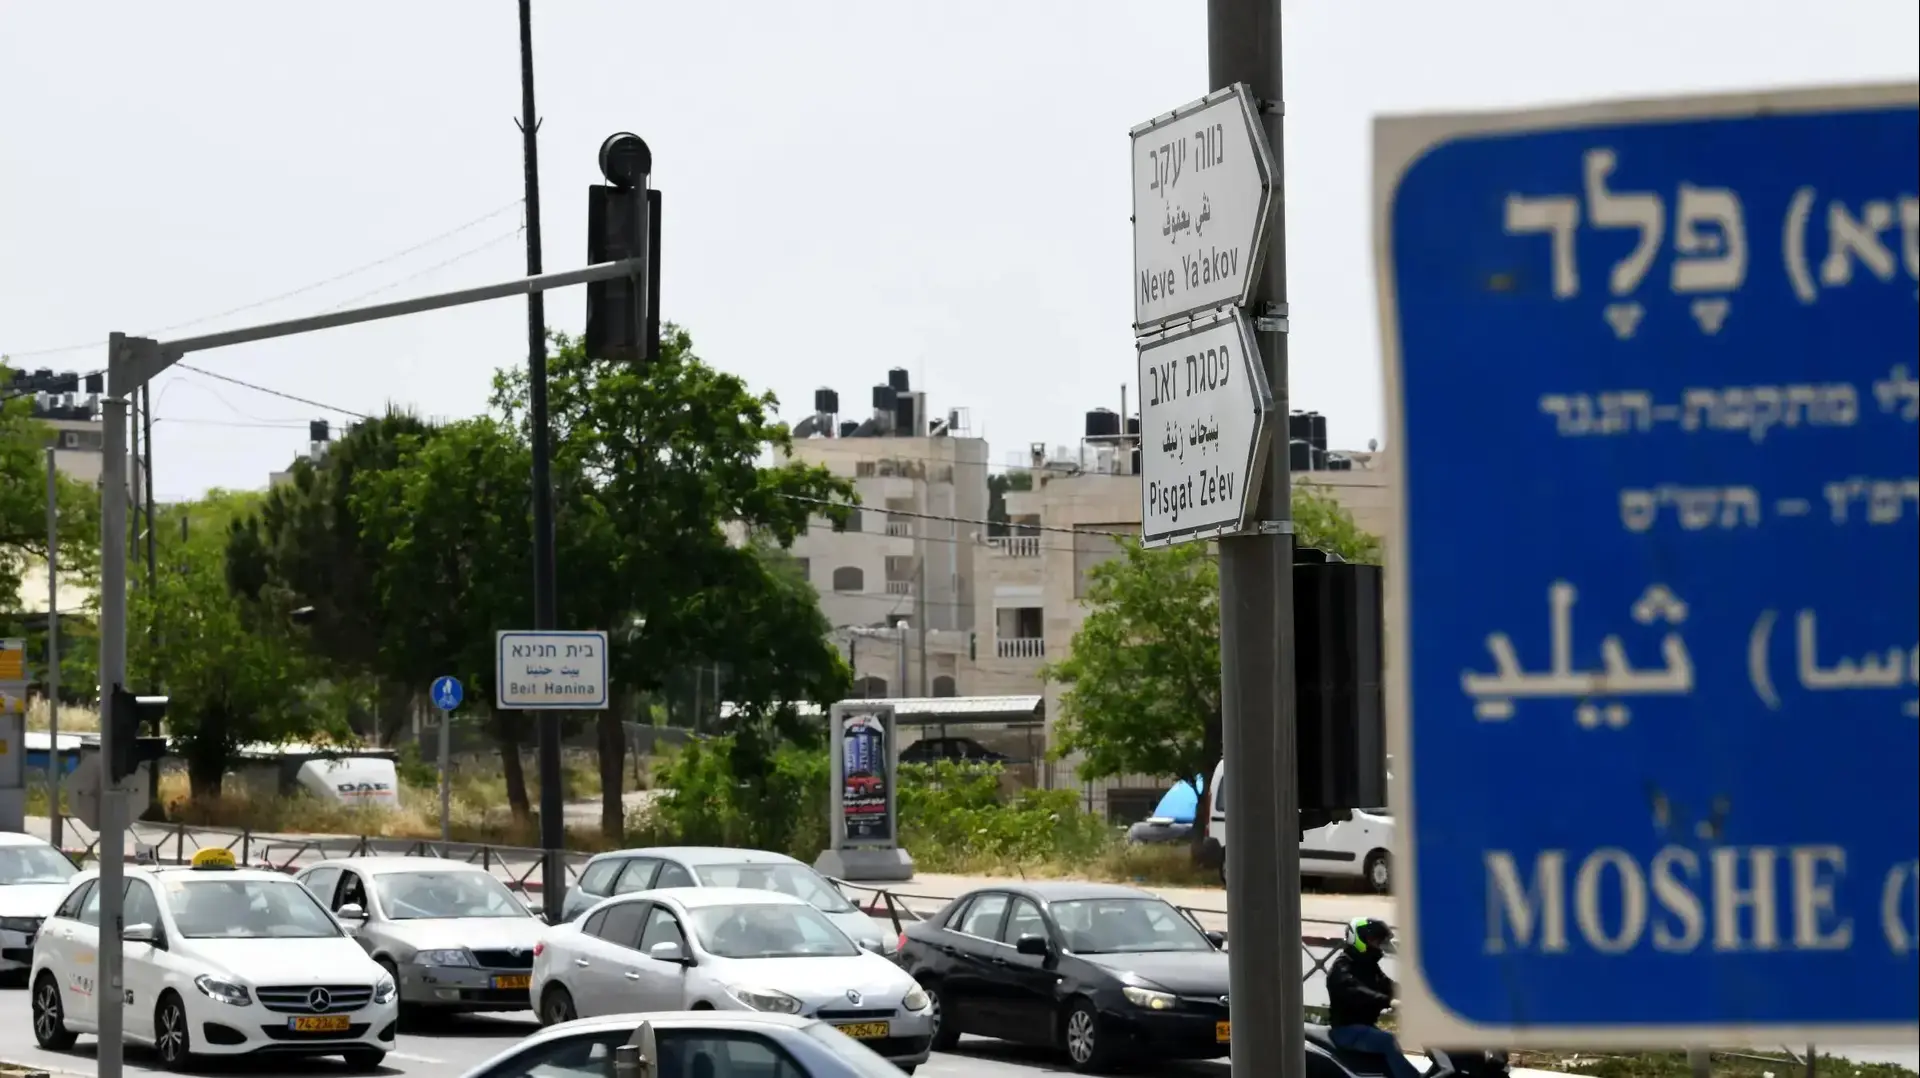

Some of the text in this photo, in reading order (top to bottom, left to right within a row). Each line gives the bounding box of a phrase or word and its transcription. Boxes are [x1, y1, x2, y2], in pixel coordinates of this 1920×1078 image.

[1149, 123, 1224, 199] נווה יעקב
[1141, 245, 1238, 306] Neve Ya'akov
[1149, 344, 1230, 408] פסגת זאב
[1149, 464, 1234, 523] Pisgat Ze'ev
[511, 644, 594, 658] בית חנינא
[510, 682, 595, 695] Beit Hanina
[1484, 845, 1852, 955] MOSHE
